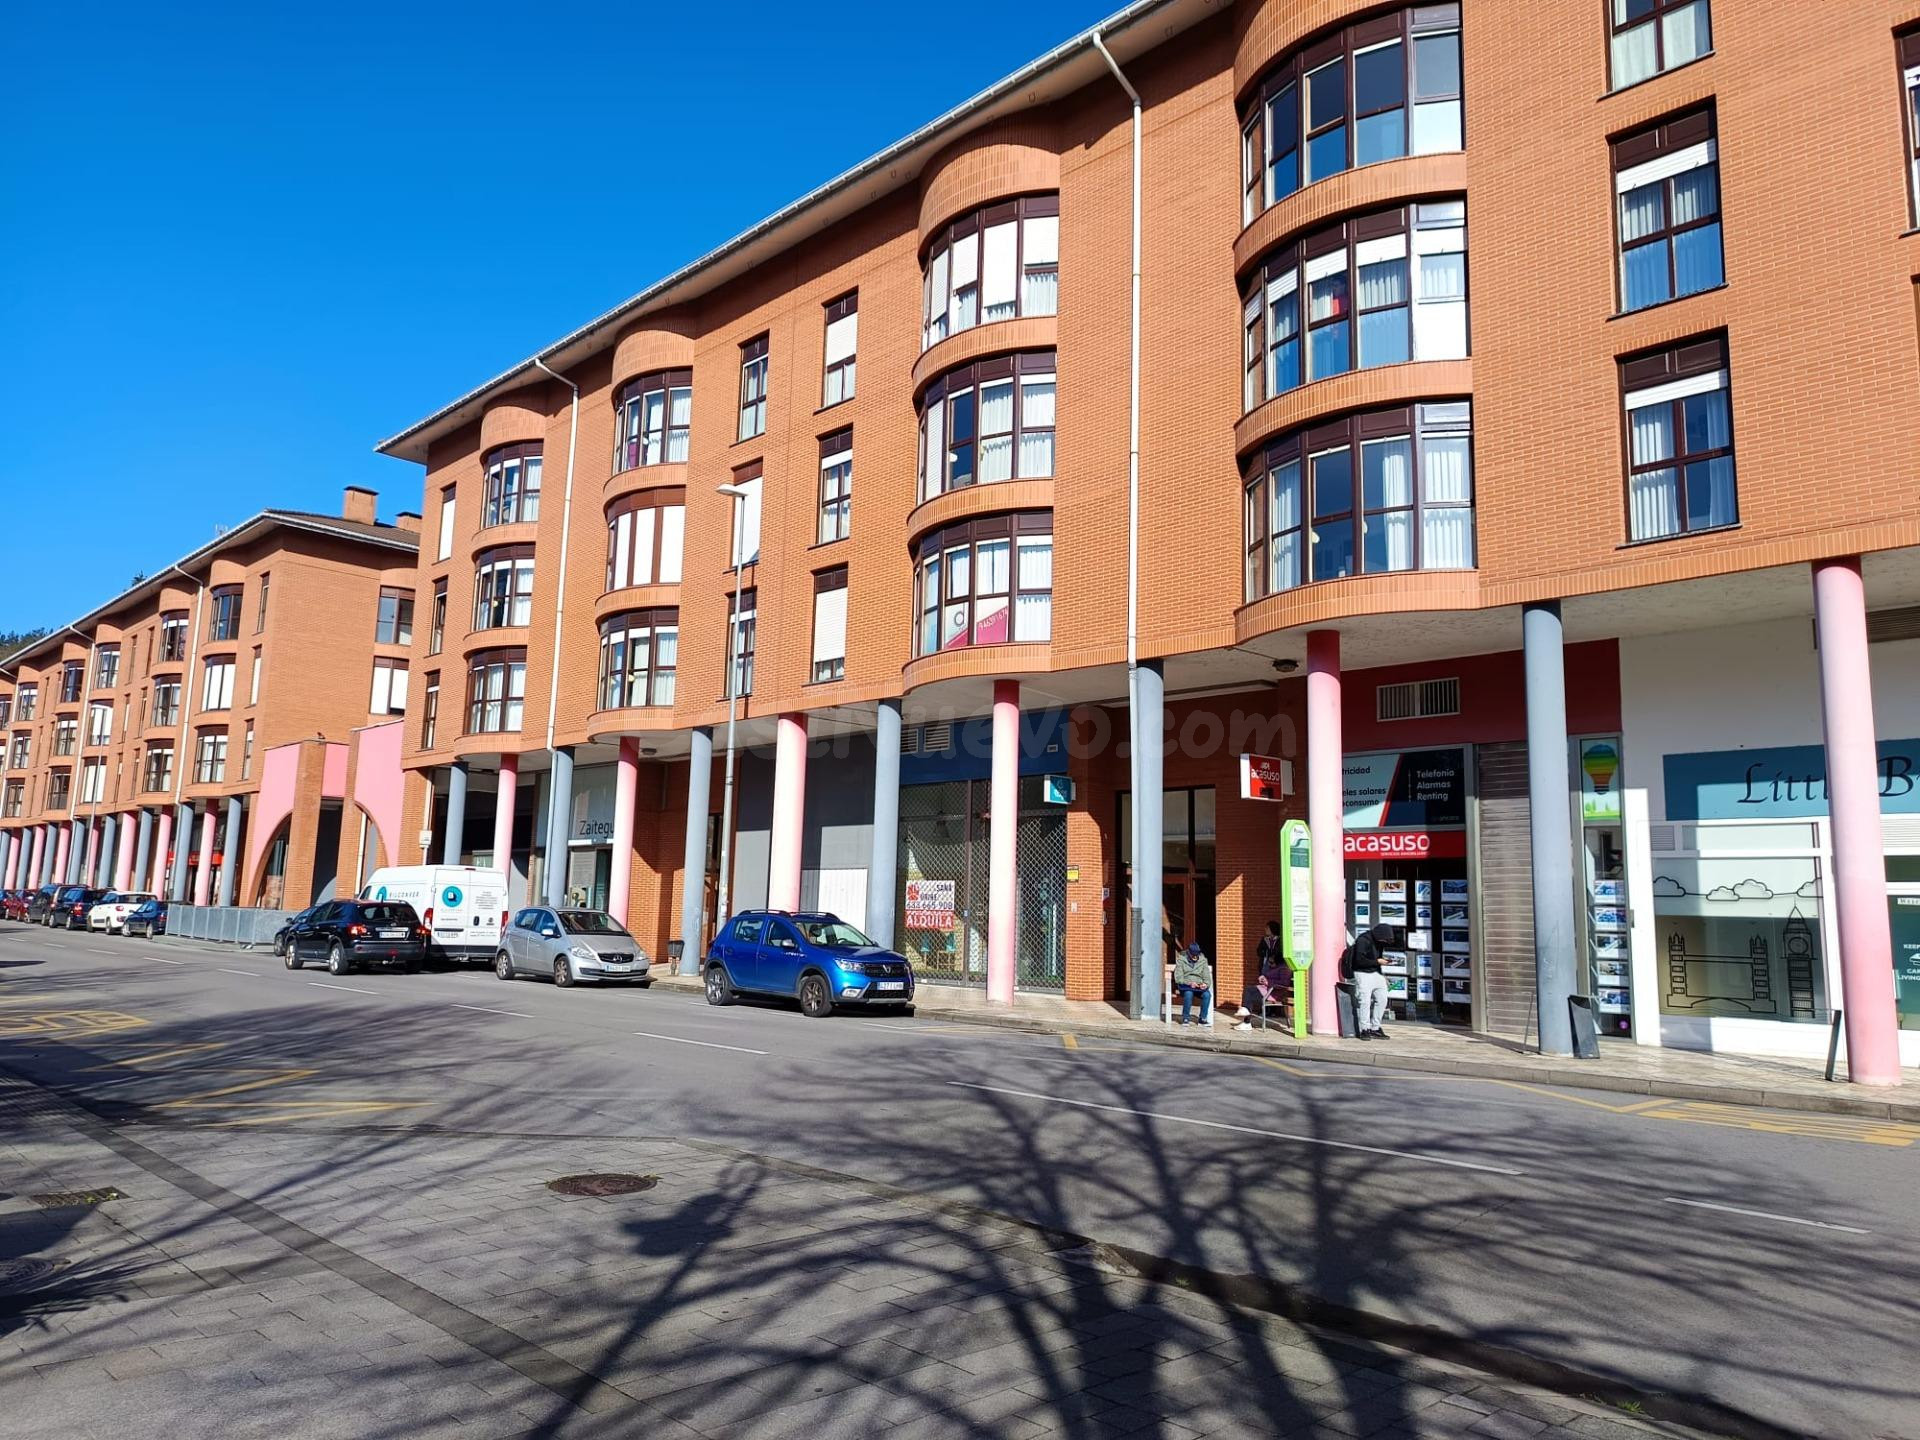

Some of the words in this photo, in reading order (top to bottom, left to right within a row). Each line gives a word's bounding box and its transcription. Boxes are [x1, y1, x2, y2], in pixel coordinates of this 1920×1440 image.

[1251, 768, 1280, 781] acasuso
[1416, 781, 1451, 789] Alarmas
[1359, 787, 1386, 795] solares
[1416, 792, 1449, 802] Renting
[1344, 834, 1430, 852] acasuso
[906, 914, 953, 928] ALQUILA
